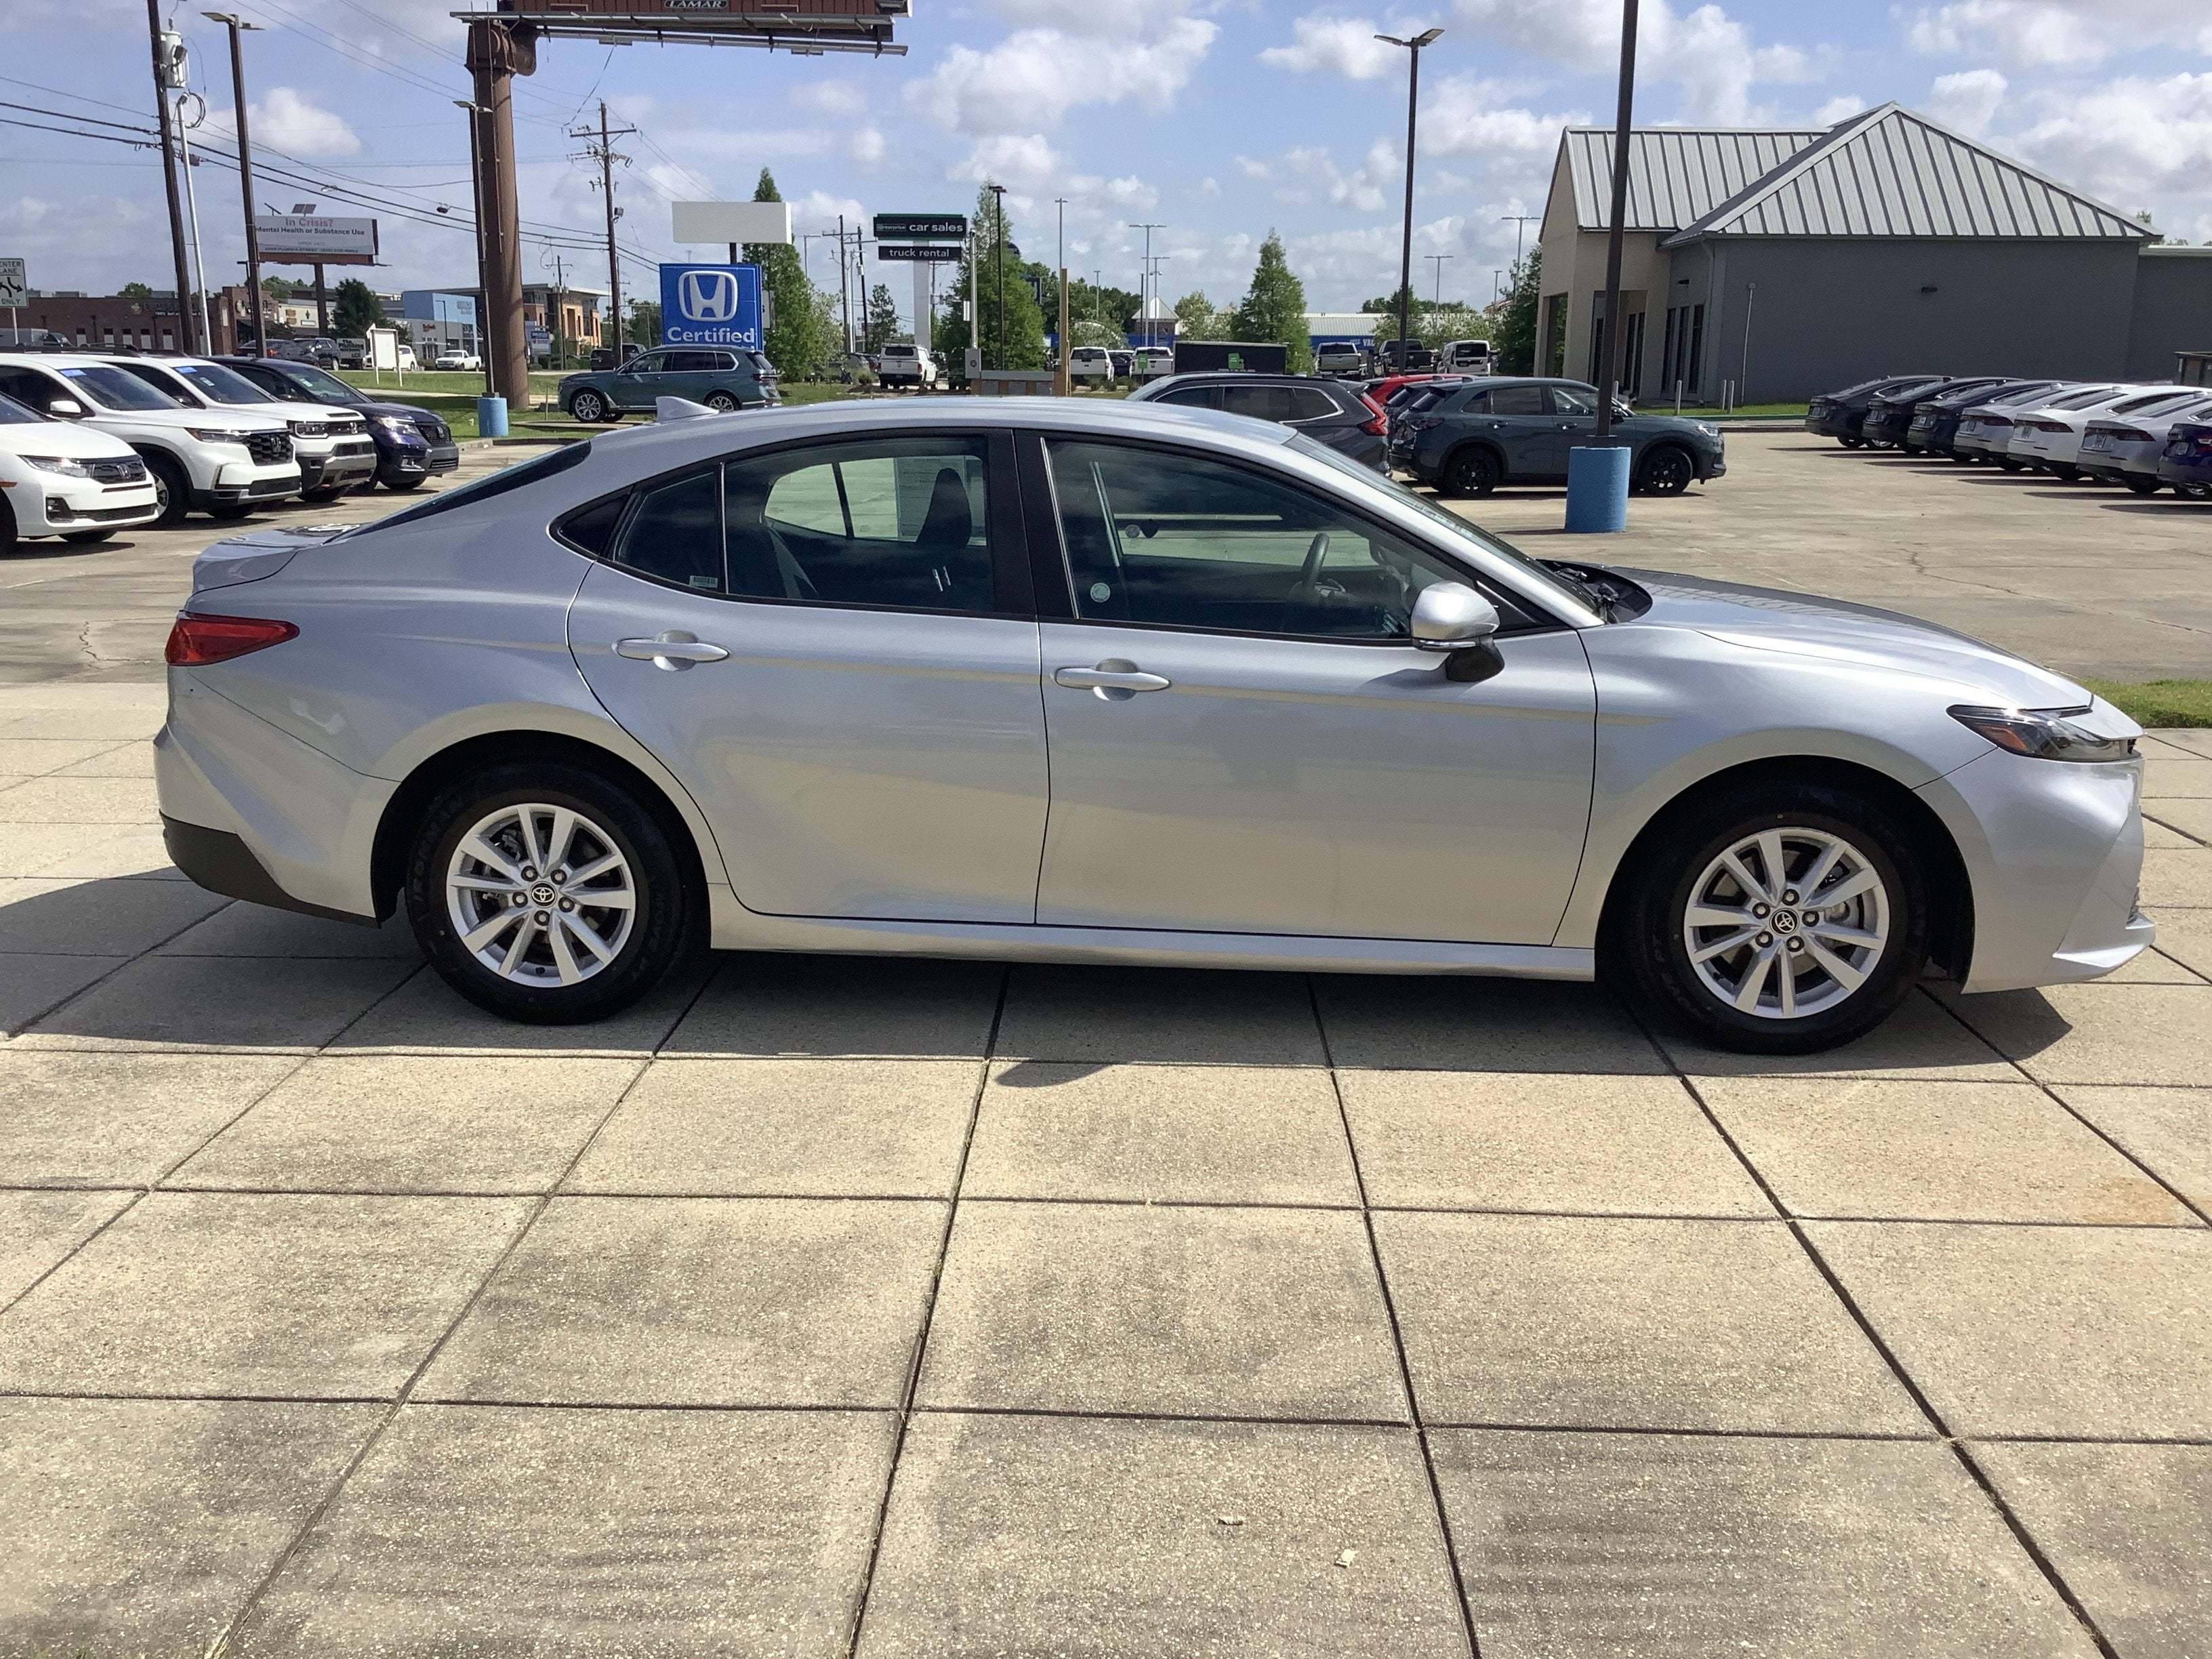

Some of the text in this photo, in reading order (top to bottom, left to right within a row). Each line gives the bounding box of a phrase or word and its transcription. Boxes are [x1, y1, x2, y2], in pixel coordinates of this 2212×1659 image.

[285, 218, 333, 227] In Crisis?
[909, 224, 929, 232] car
[931, 222, 964, 232] sales
[889, 248, 949, 257] truck rental
[667, 327, 755, 343] Certified
